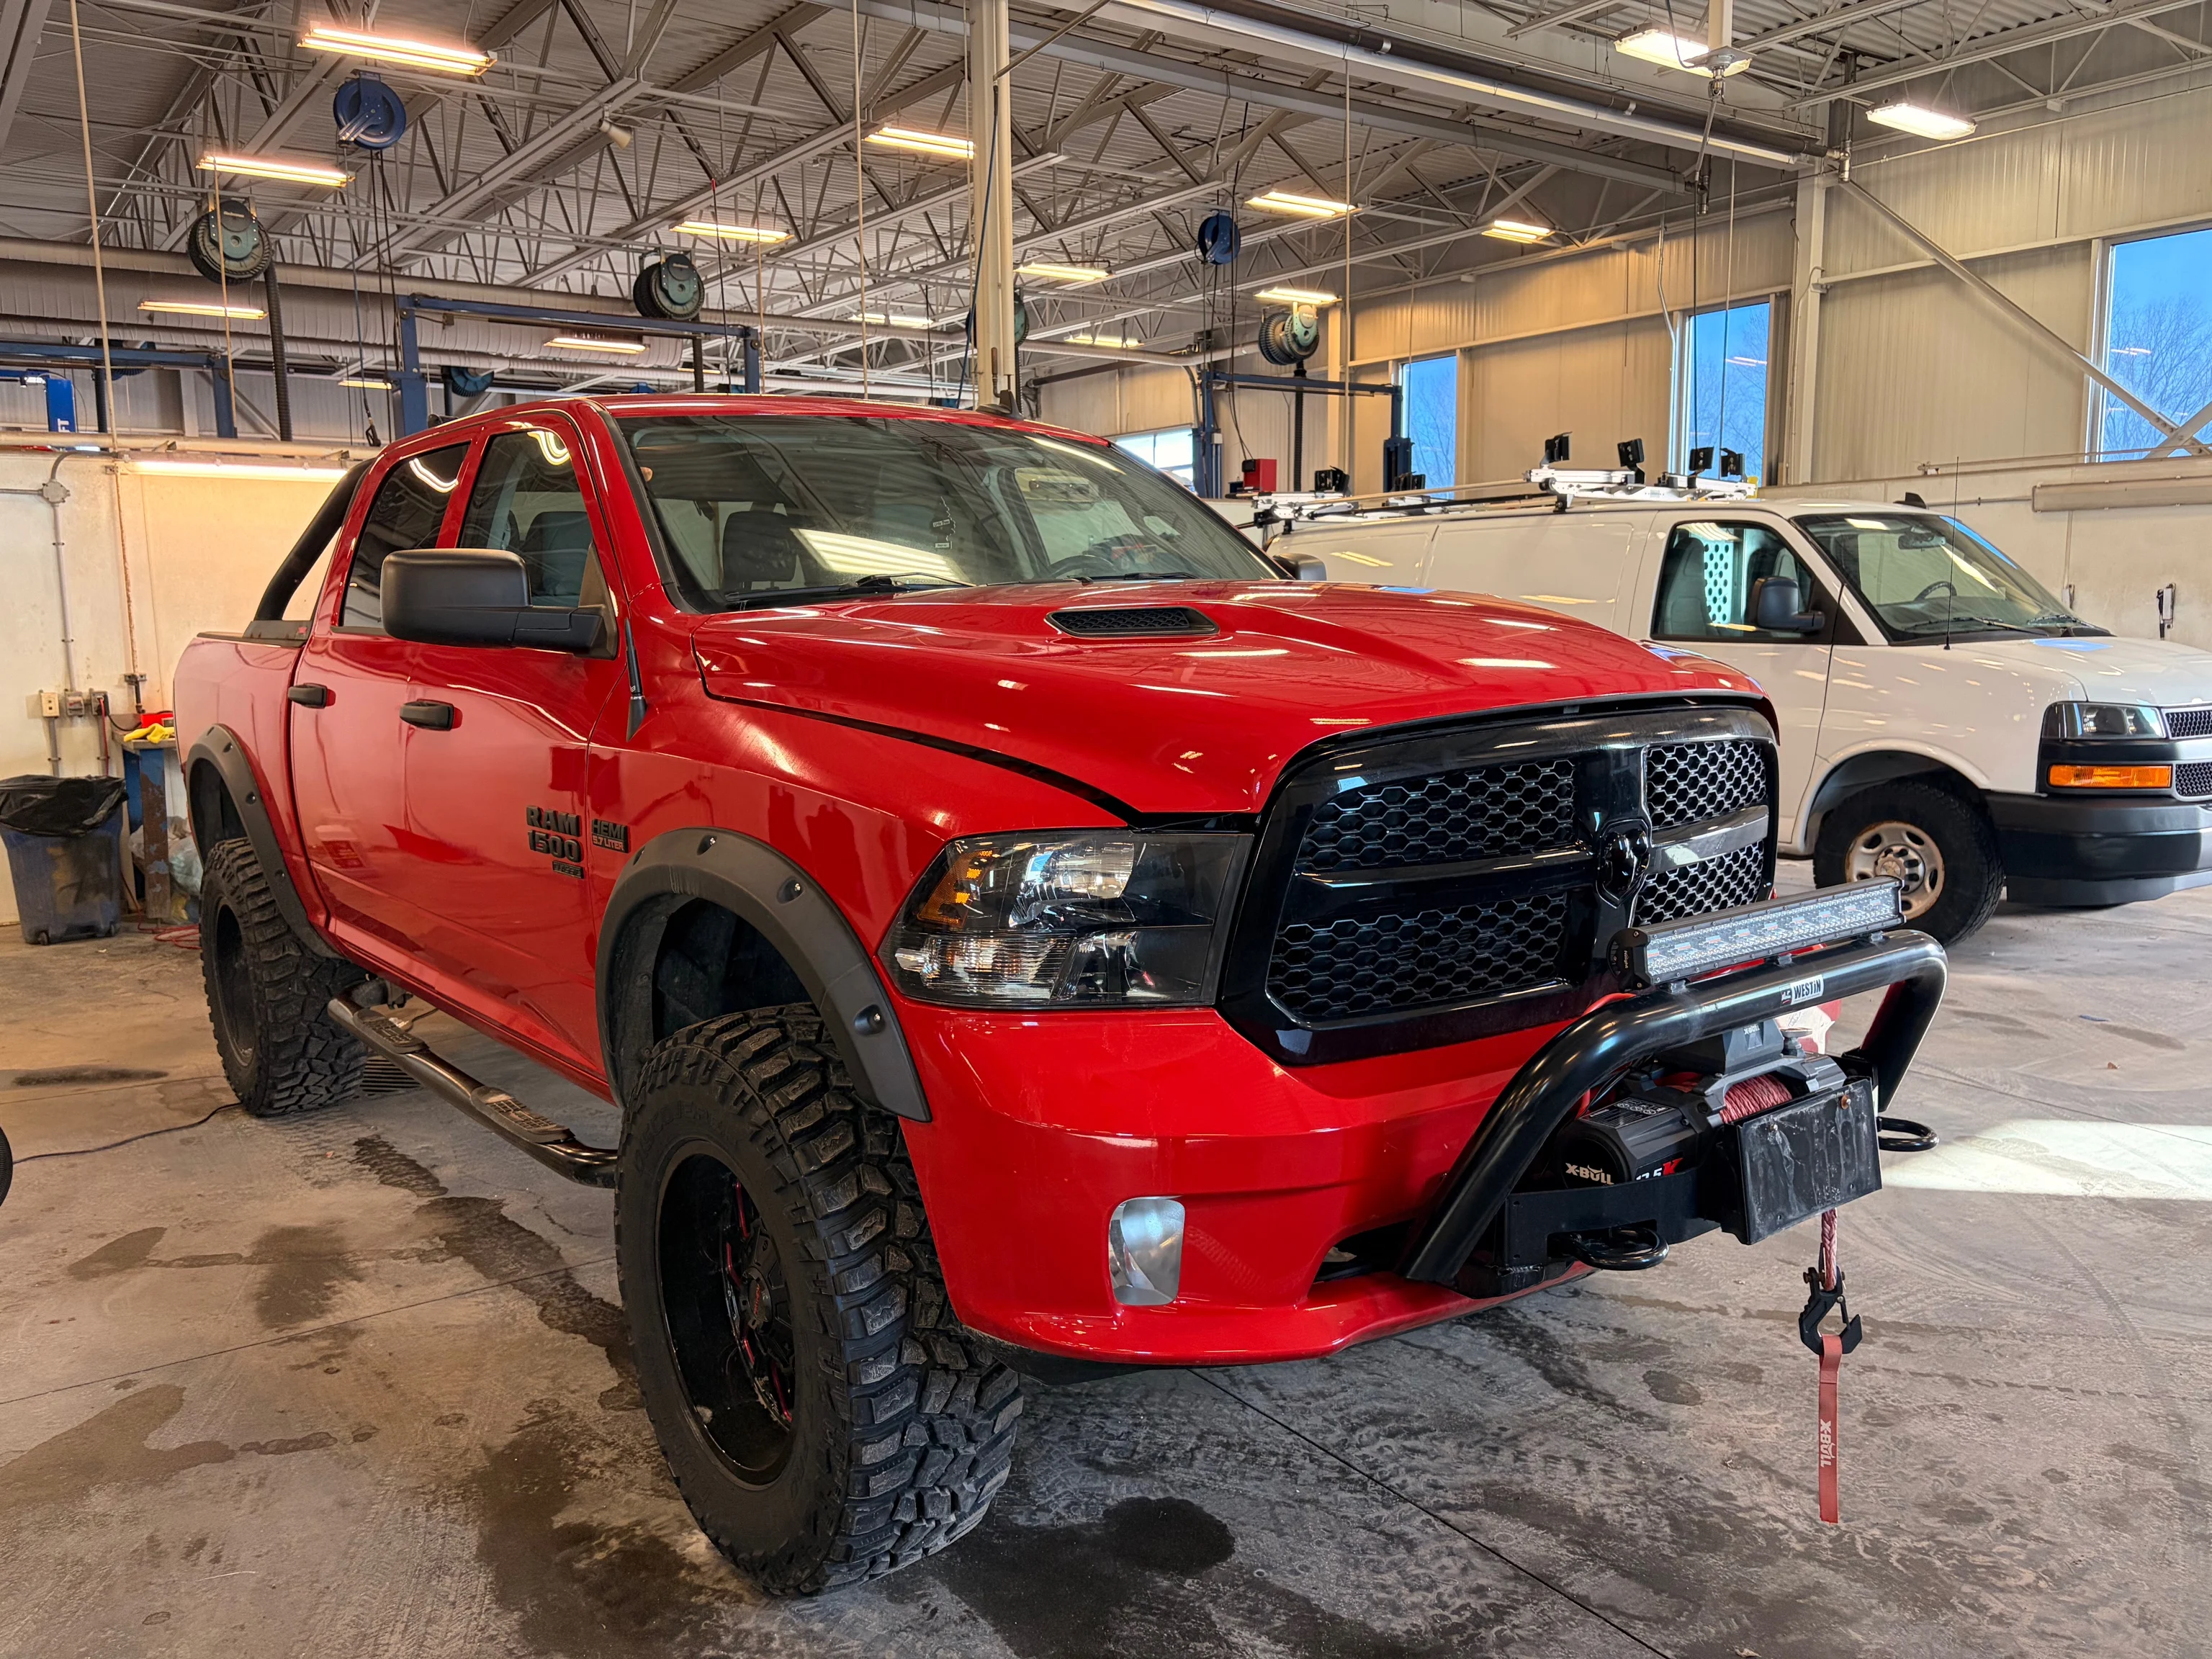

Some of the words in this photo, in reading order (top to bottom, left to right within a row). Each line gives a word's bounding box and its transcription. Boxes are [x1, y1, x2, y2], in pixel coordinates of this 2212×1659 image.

[526, 805, 580, 837] RAM
[593, 819, 625, 840] HEMI
[528, 830, 582, 863] 1500
[593, 835, 603, 845] 5.7
[604, 837, 624, 851] LITER
[1565, 1162, 1614, 1185] X-BULL
[1820, 1418, 1836, 1467] X-BULL
